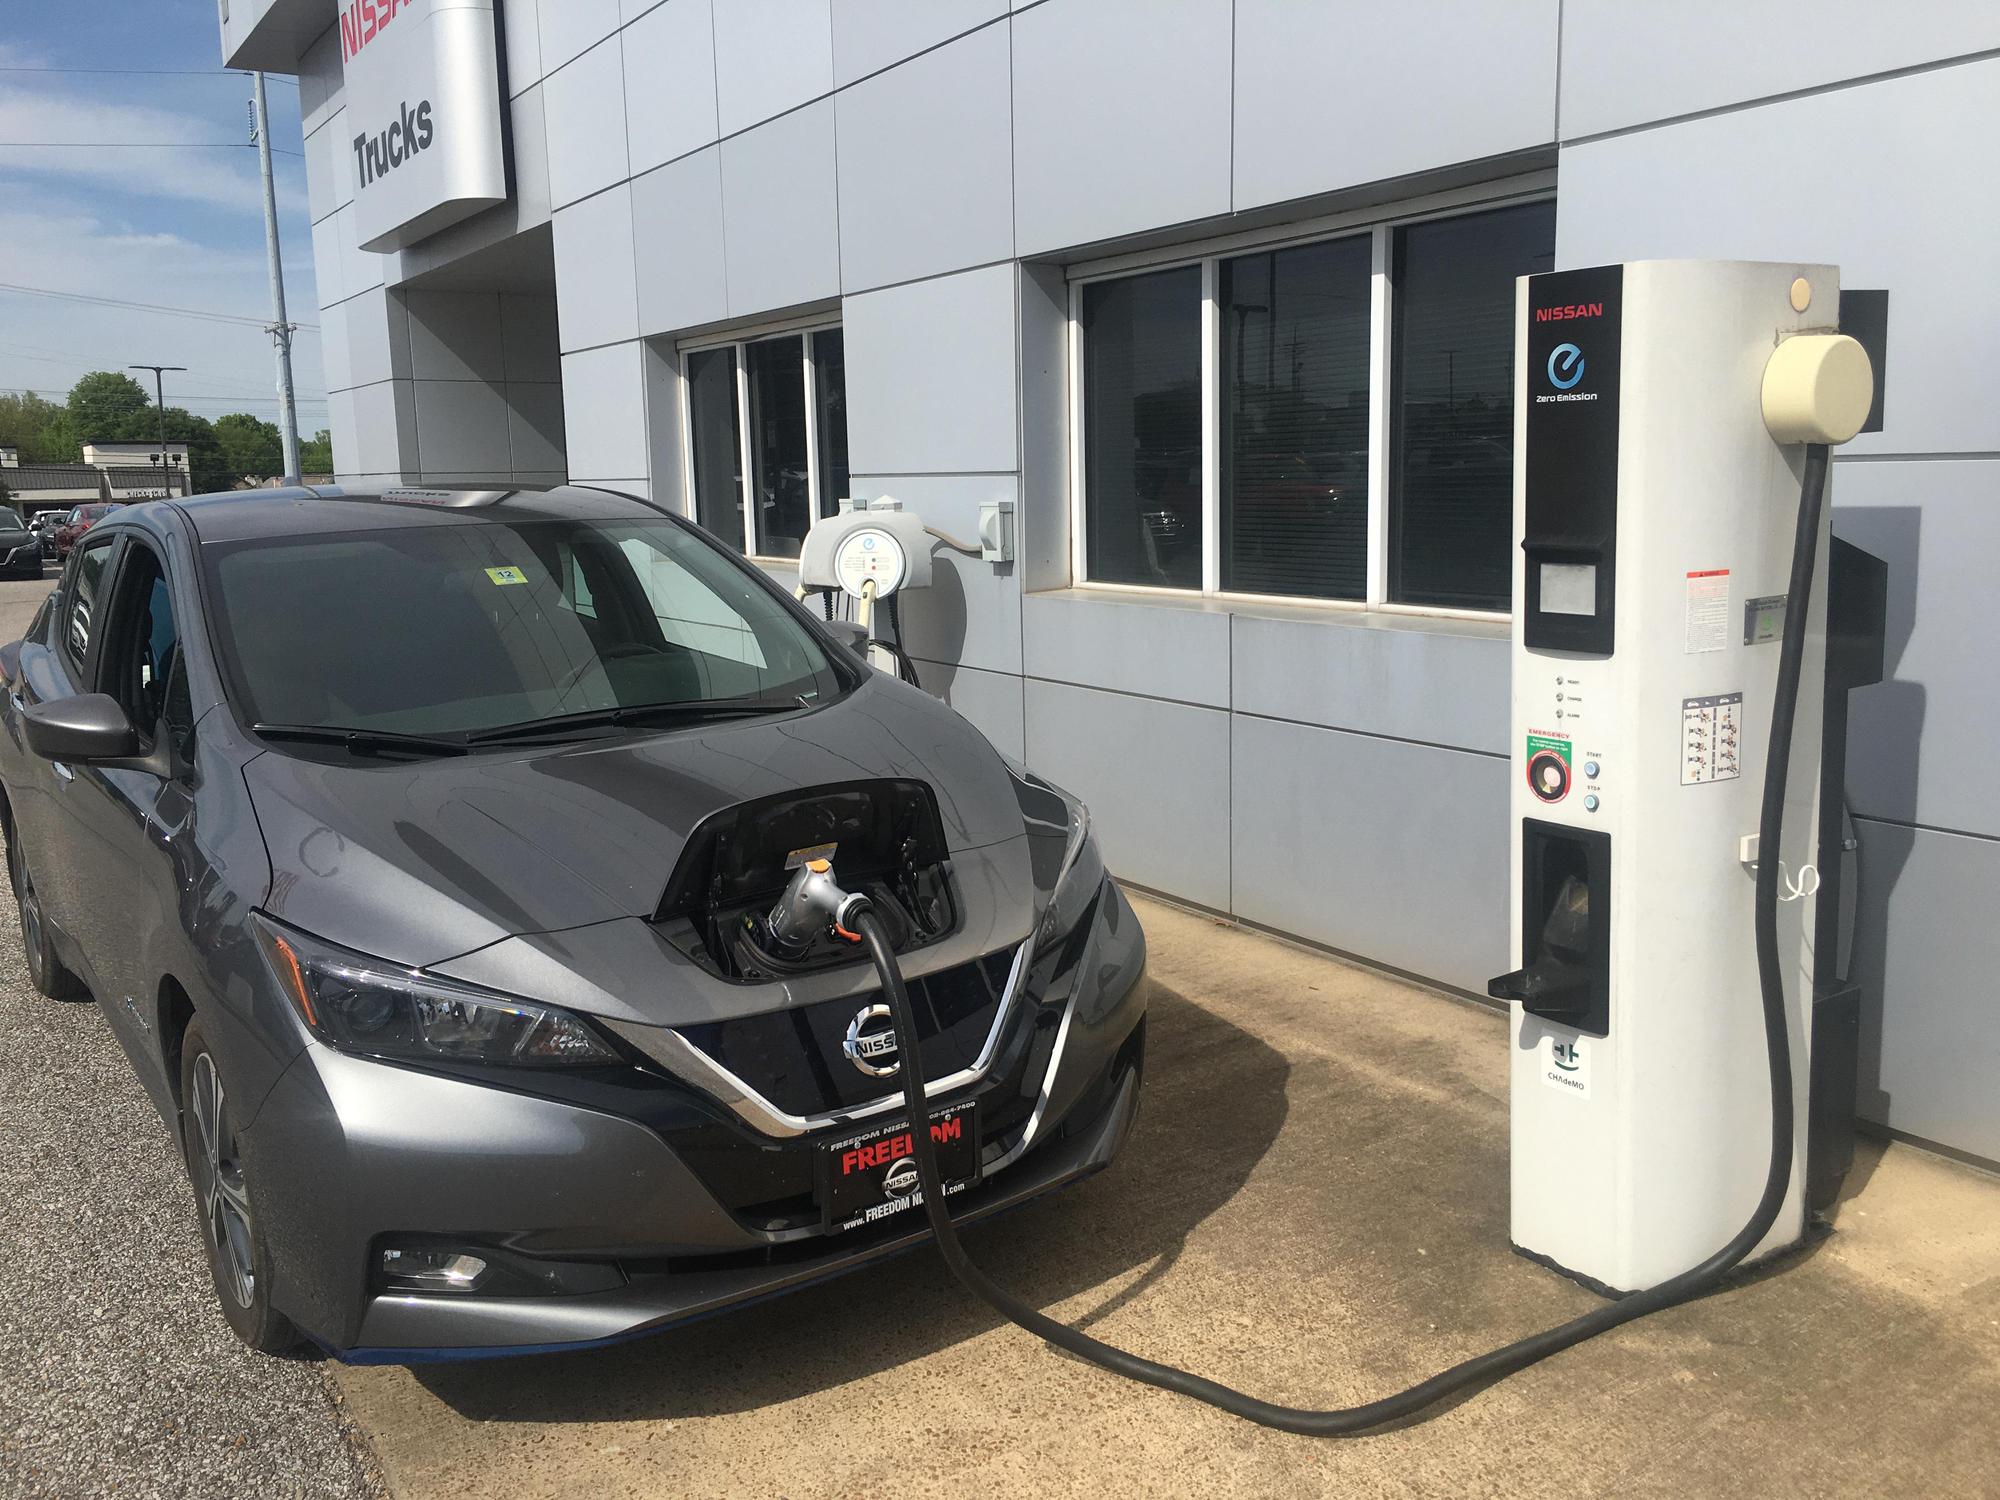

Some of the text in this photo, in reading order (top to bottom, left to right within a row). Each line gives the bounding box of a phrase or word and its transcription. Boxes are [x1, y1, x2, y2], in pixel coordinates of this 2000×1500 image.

[341, 0, 412, 64] NISS
[353, 99, 433, 189] Trucks
[1536, 303, 1603, 322] NISSAN
[1536, 393, 1598, 403] Zero Emission
[498, 570, 515, 579] 12
[1528, 728, 1570, 739] EMERGENCY
[855, 1033, 895, 1056] NISS
[1548, 1072, 1585, 1090] CHAdeMO
[830, 1130, 880, 1151] FREEDOM
[883, 1122, 910, 1135] NISS
[843, 1217, 865, 1231] www.
[865, 1196, 910, 1222] FREEDOM
